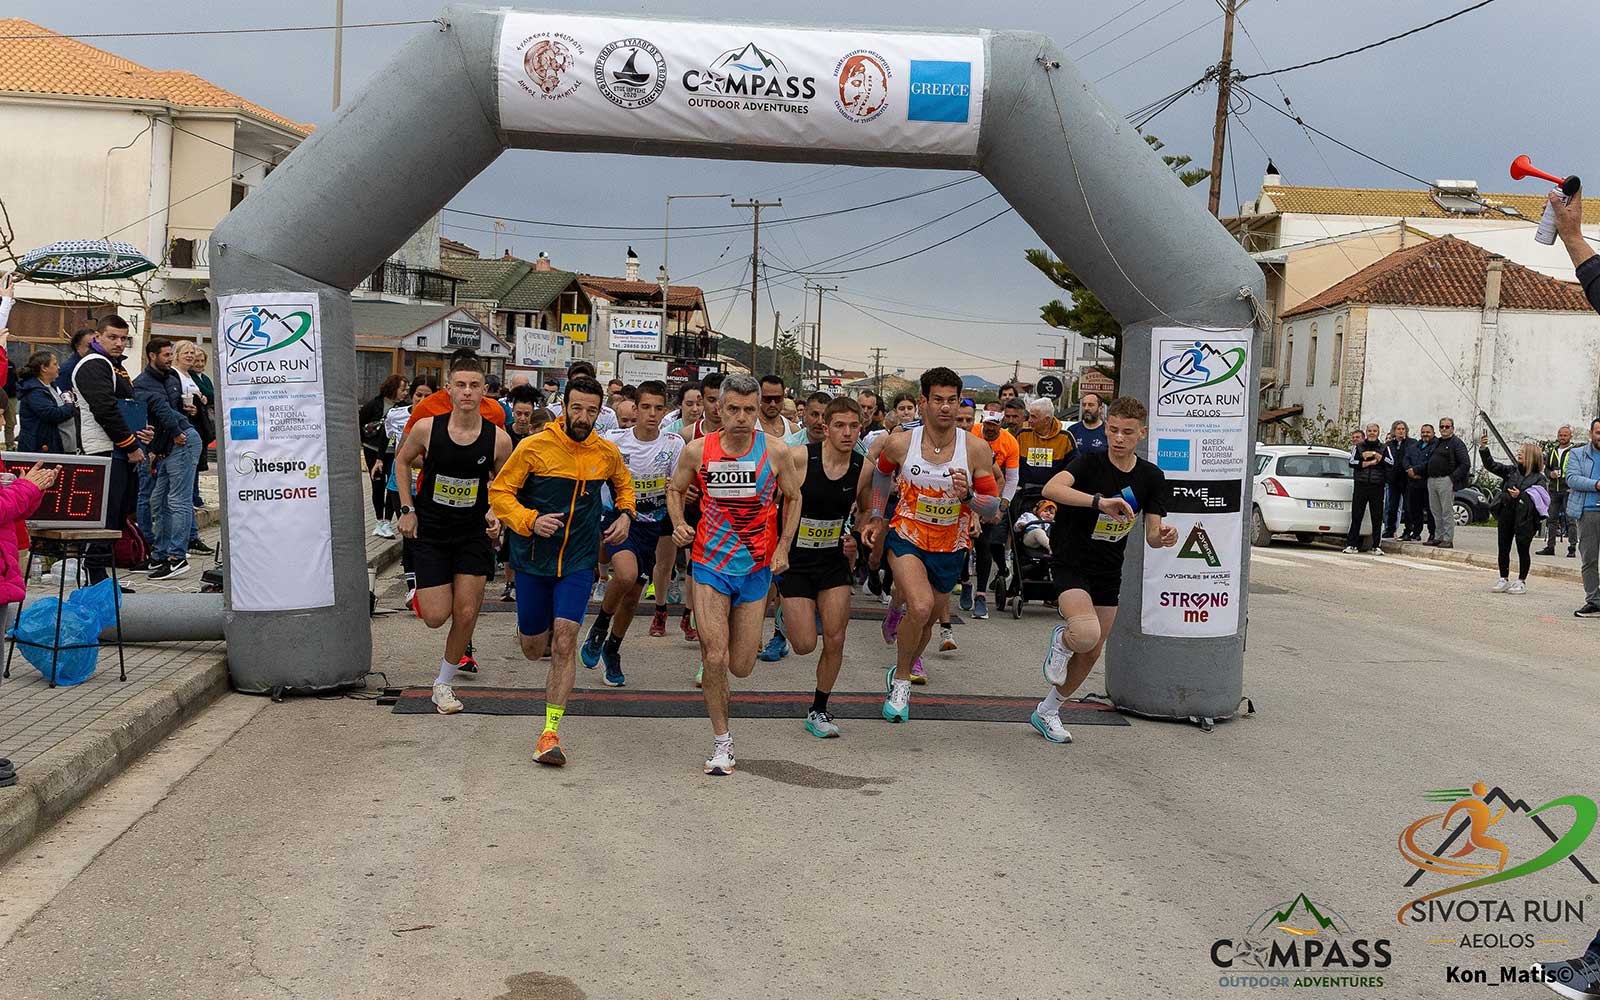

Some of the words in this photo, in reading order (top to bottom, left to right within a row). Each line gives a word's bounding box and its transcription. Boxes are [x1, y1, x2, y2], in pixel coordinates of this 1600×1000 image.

[911, 82, 969, 96] GREECE
[688, 98, 740, 110] OUTDOOR
[743, 102, 809, 114] ADVENTURES
[562, 323, 587, 332] ATM
[231, 360, 276, 373] SIVOTA
[280, 359, 309, 370] RUN
[250, 375, 287, 384] AEOLOS
[1164, 394, 1213, 405] SIVOTA
[1216, 394, 1240, 405] RUN
[1186, 409, 1221, 417] AEOLOS
[269, 424, 321, 432] ORGANISATION
[1158, 450, 1189, 458] GREECE
[711, 472, 750, 483] 20011
[239, 487, 317, 501] EPIRUSGATE
[441, 485, 471, 496] 5090
[1173, 487, 1208, 497] FRAME
[1201, 497, 1227, 506] REEL
[925, 505, 953, 514] 5106
[807, 528, 834, 537] 5015
[1160, 592, 1229, 609] STRONG
[1184, 609, 1208, 622] me
